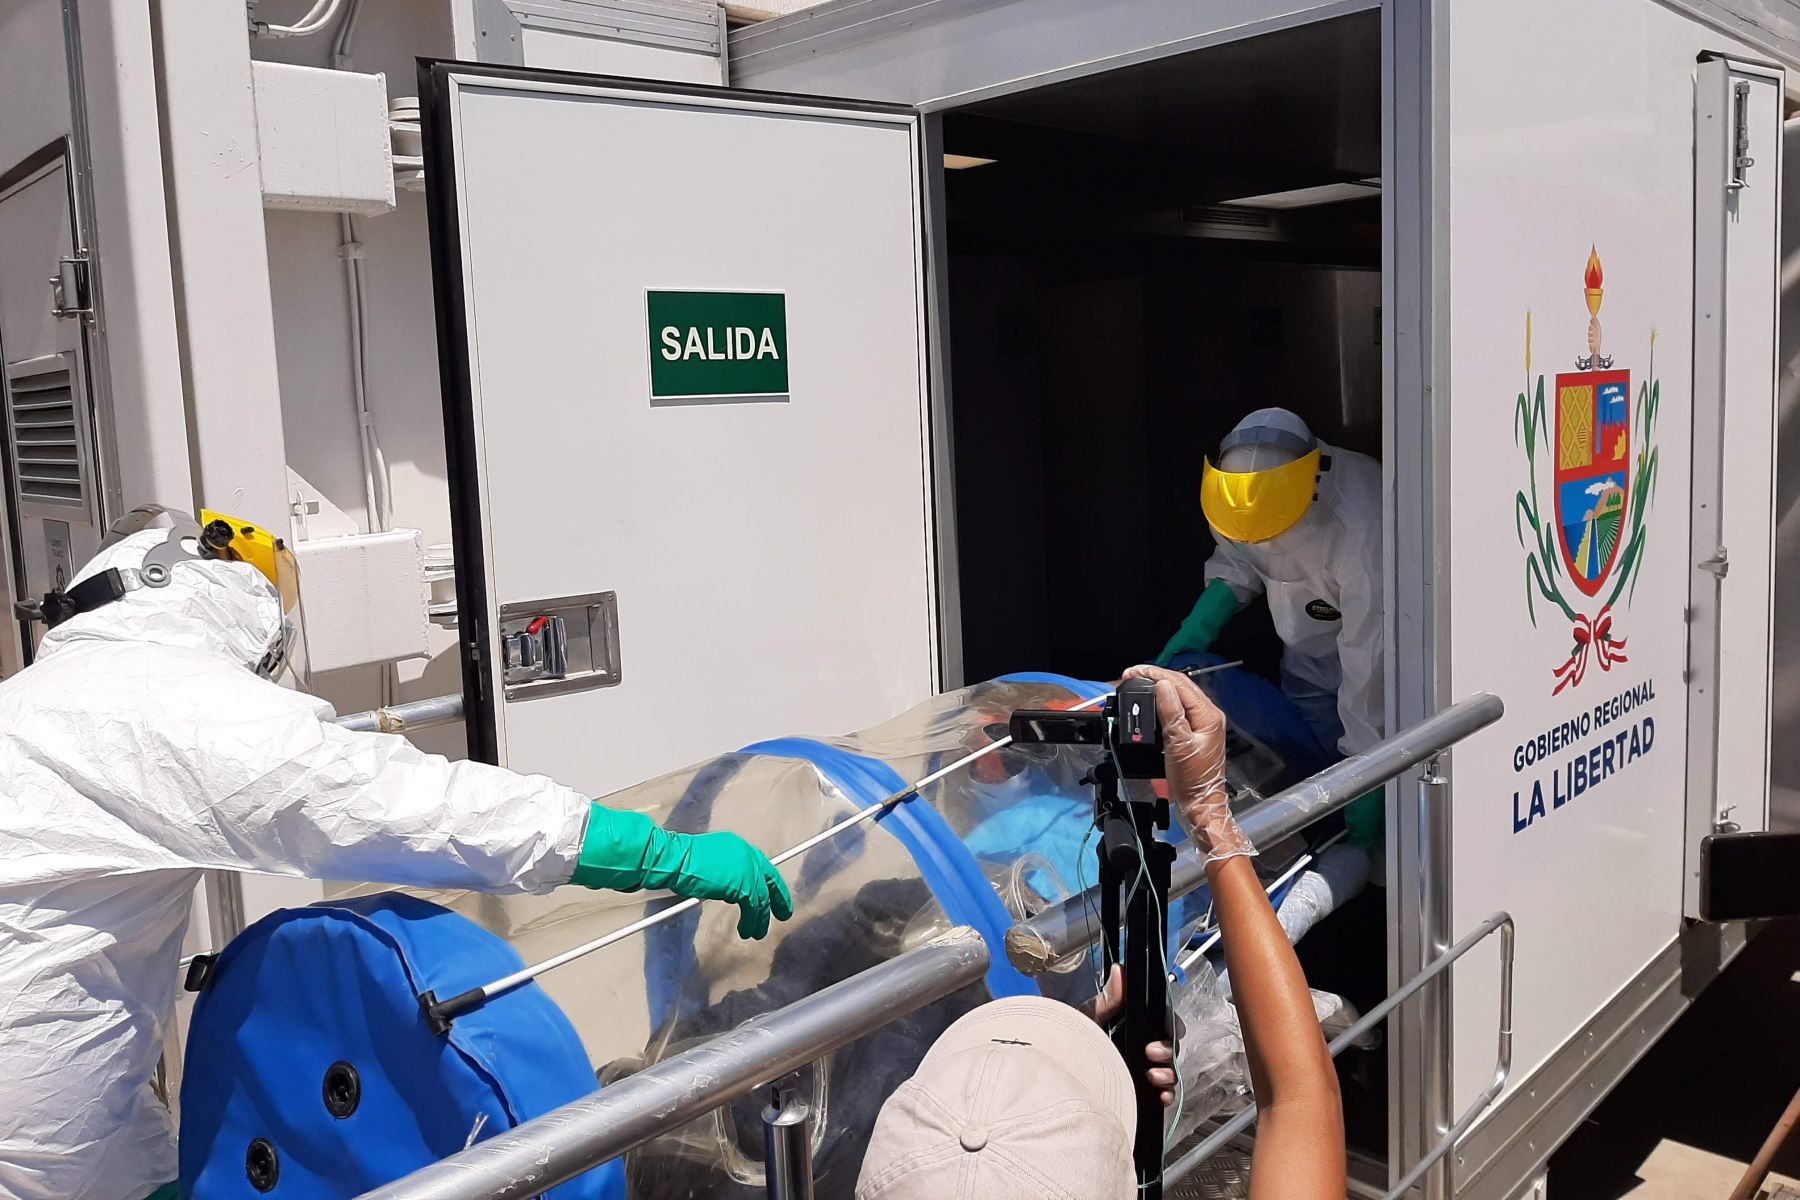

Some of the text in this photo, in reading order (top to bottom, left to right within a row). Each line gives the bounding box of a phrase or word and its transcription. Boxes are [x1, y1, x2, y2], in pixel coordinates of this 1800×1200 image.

[661, 326, 779, 361] SALIDA
[1513, 678, 1655, 772] GOBIERNO REGIONAL
[1513, 716, 1655, 834] LA LIBERTAD
